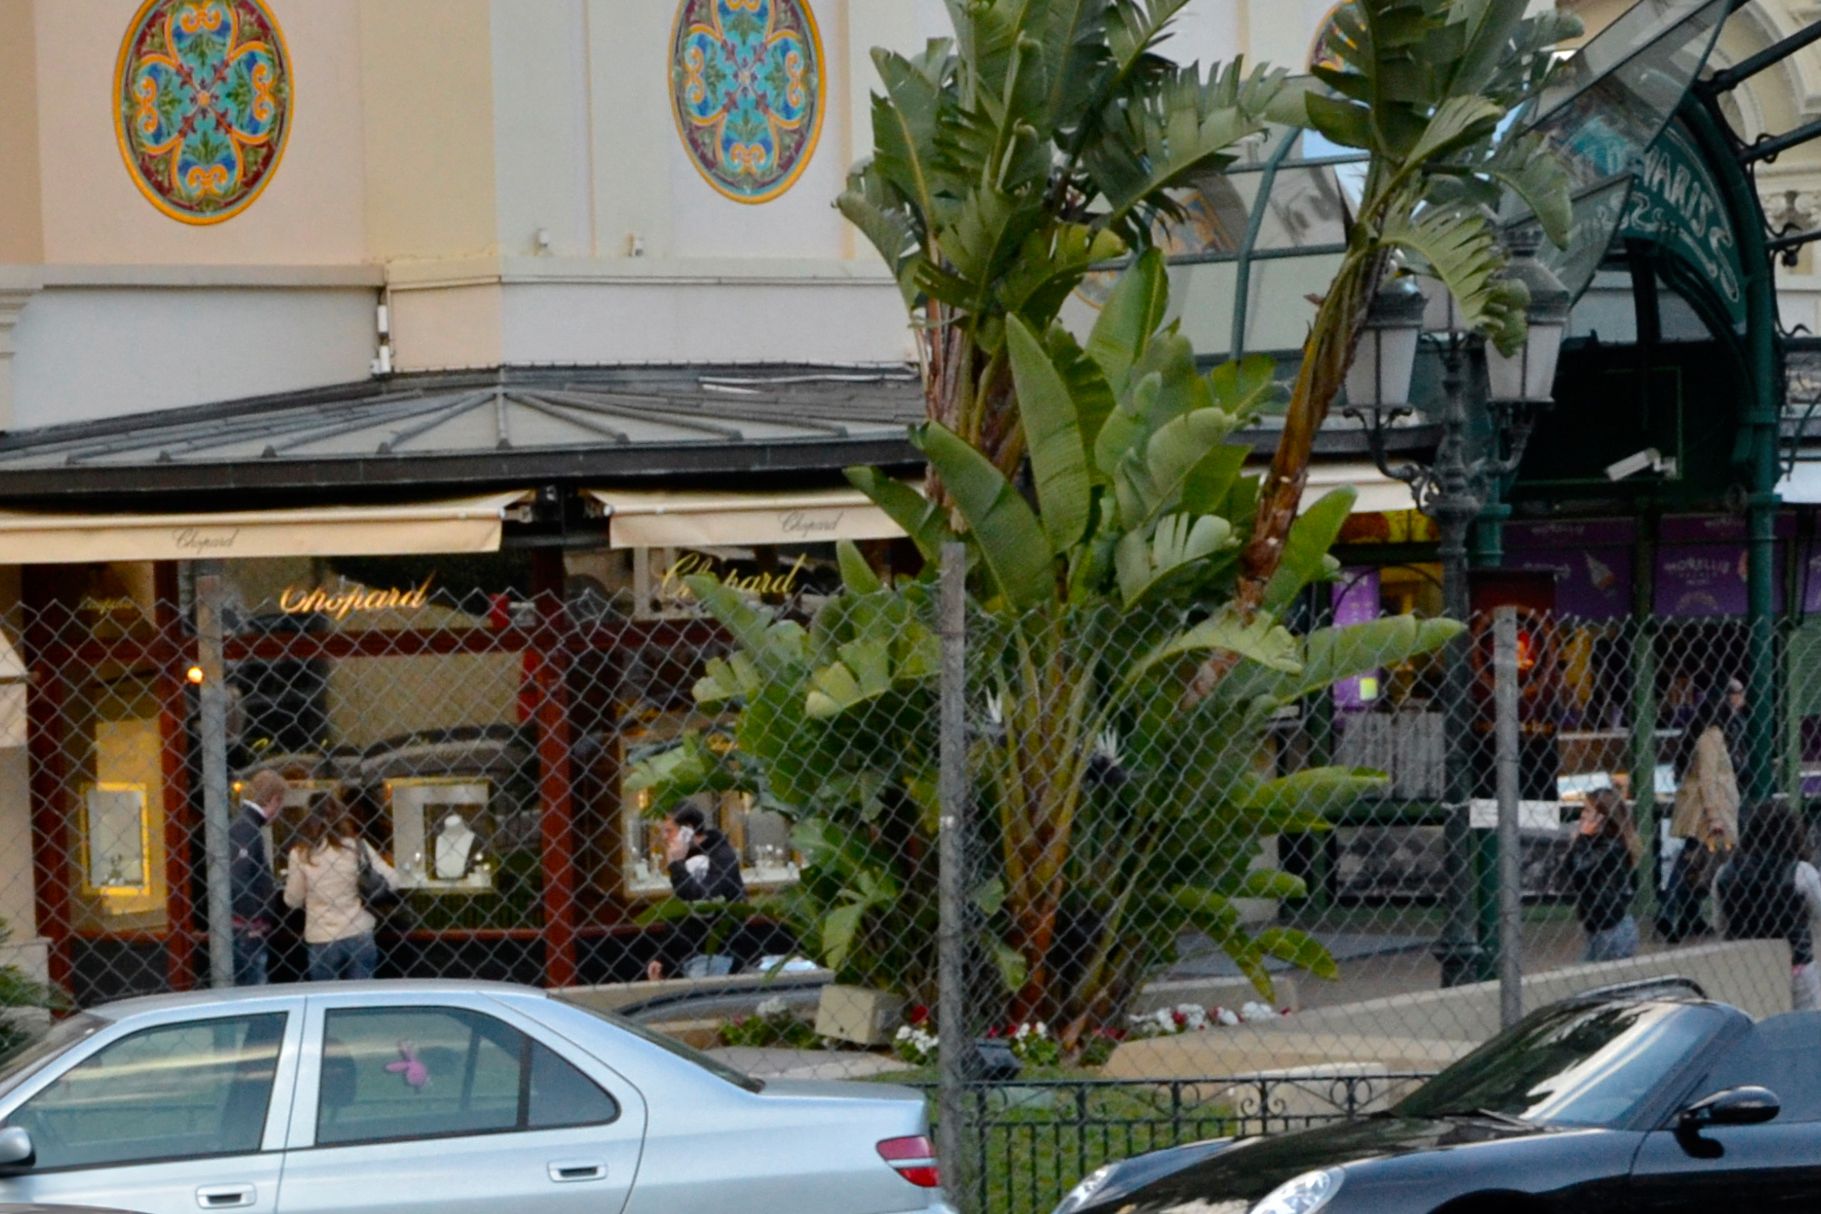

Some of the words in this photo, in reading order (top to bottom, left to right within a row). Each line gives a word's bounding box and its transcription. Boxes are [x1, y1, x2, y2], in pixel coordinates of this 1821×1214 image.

[782, 510, 844, 538] Chopard
[172, 527, 240, 554] Chopard
[280, 571, 437, 621] Chopard
